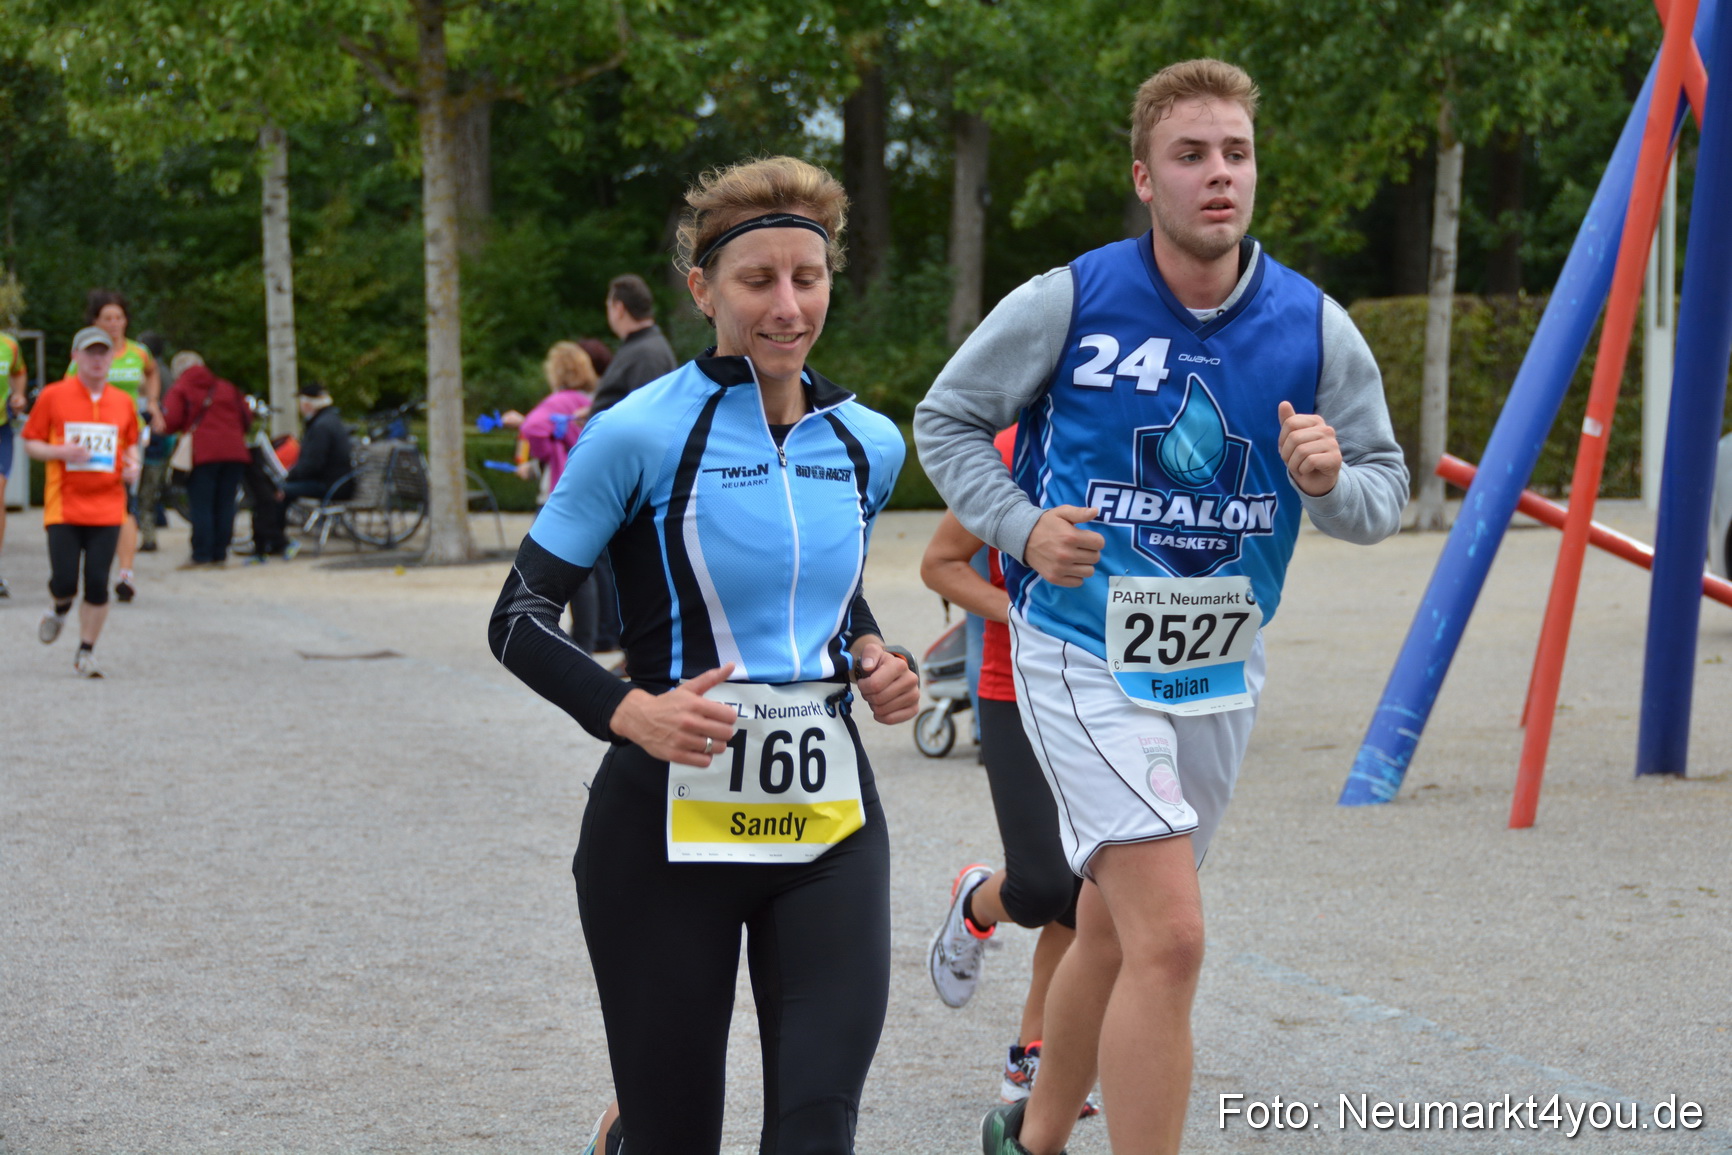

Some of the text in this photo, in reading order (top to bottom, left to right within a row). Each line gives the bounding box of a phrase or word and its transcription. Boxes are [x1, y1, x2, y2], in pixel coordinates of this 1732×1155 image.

[1073, 334, 1171, 391] 24
[722, 478, 769, 489] NEUMARKT
[1090, 486, 1276, 531] FIBALON
[1149, 532, 1228, 550] BASKETS
[1112, 591, 1240, 605] PARTL Neumarkt
[1123, 612, 1250, 666] 2527
[1151, 676, 1210, 699] Fabian
[754, 701, 823, 720] Neumarkt
[726, 727, 827, 795] 166
[730, 811, 807, 841] Sandy
